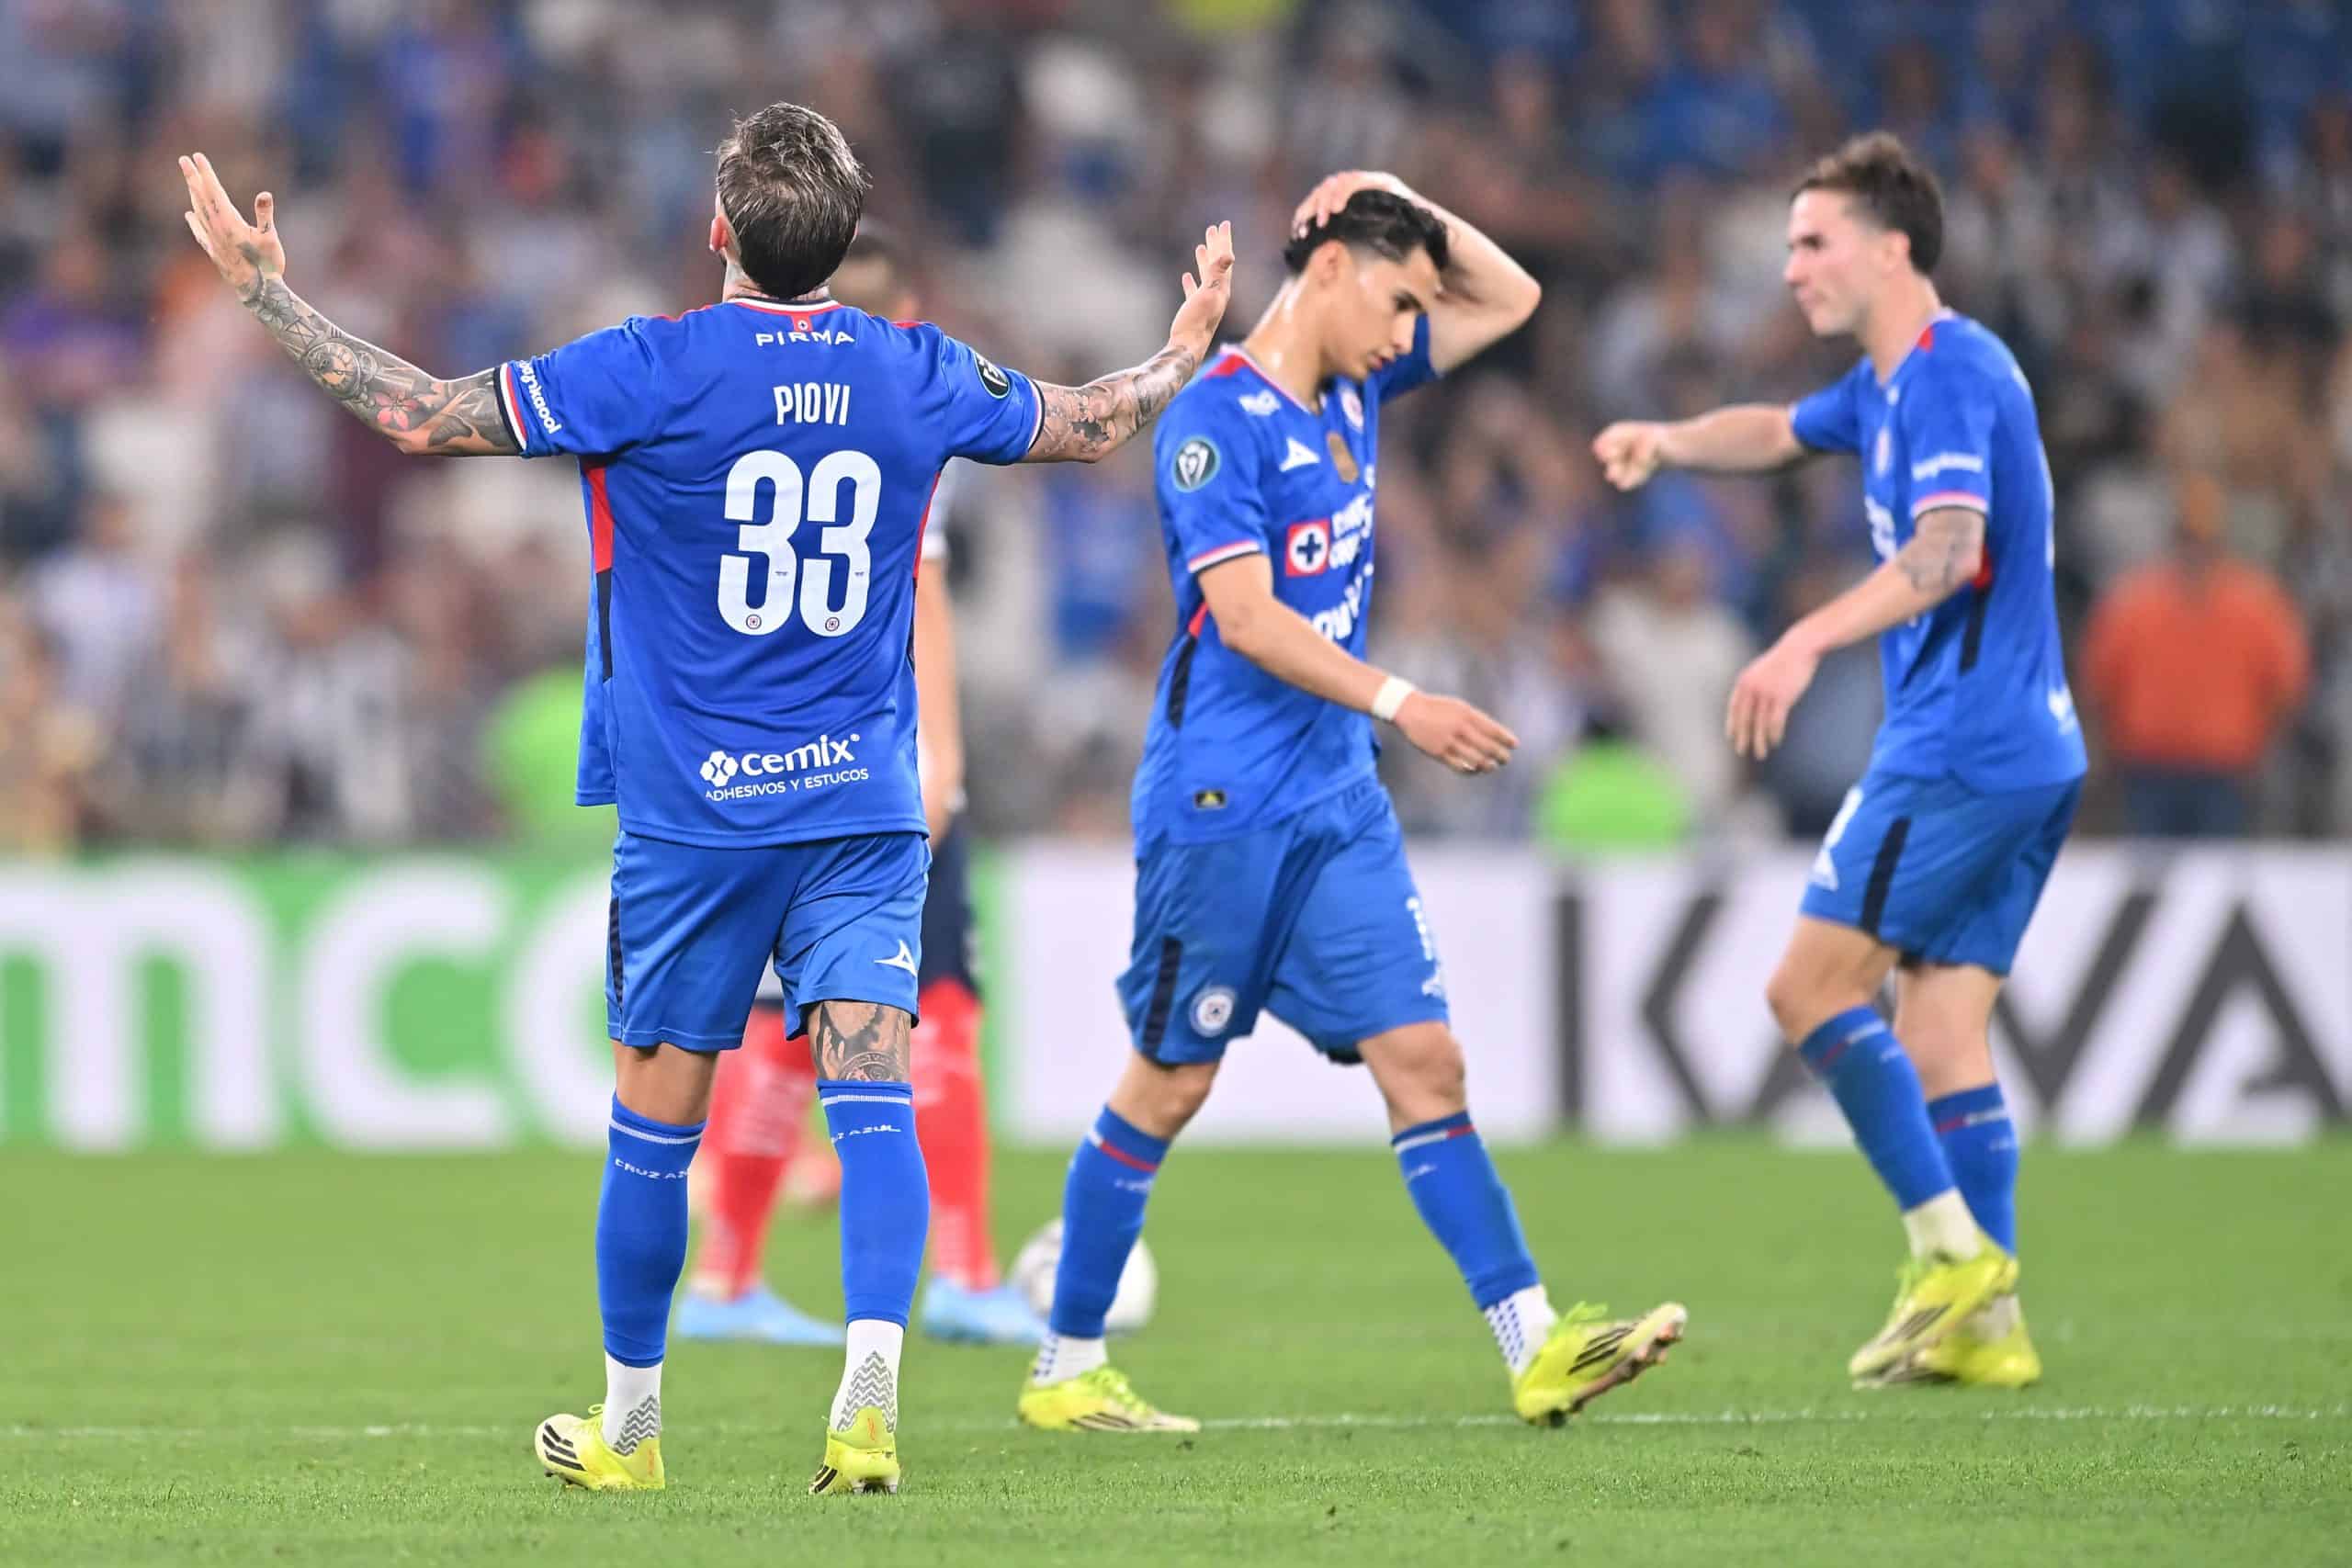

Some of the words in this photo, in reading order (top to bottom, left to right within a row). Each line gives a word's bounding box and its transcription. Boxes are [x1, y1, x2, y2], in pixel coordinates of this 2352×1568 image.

[755, 329, 855, 347] PIRMA
[773, 382, 850, 426] PIOVI
[718, 450, 881, 637] 33
[706, 781, 786, 802] ADHESIVOS
[790, 779, 800, 791] Y
[805, 768, 869, 789] ESTUCOS
[1553, 886, 2352, 1125] KVA
[615, 1158, 661, 1179] CRUZ
